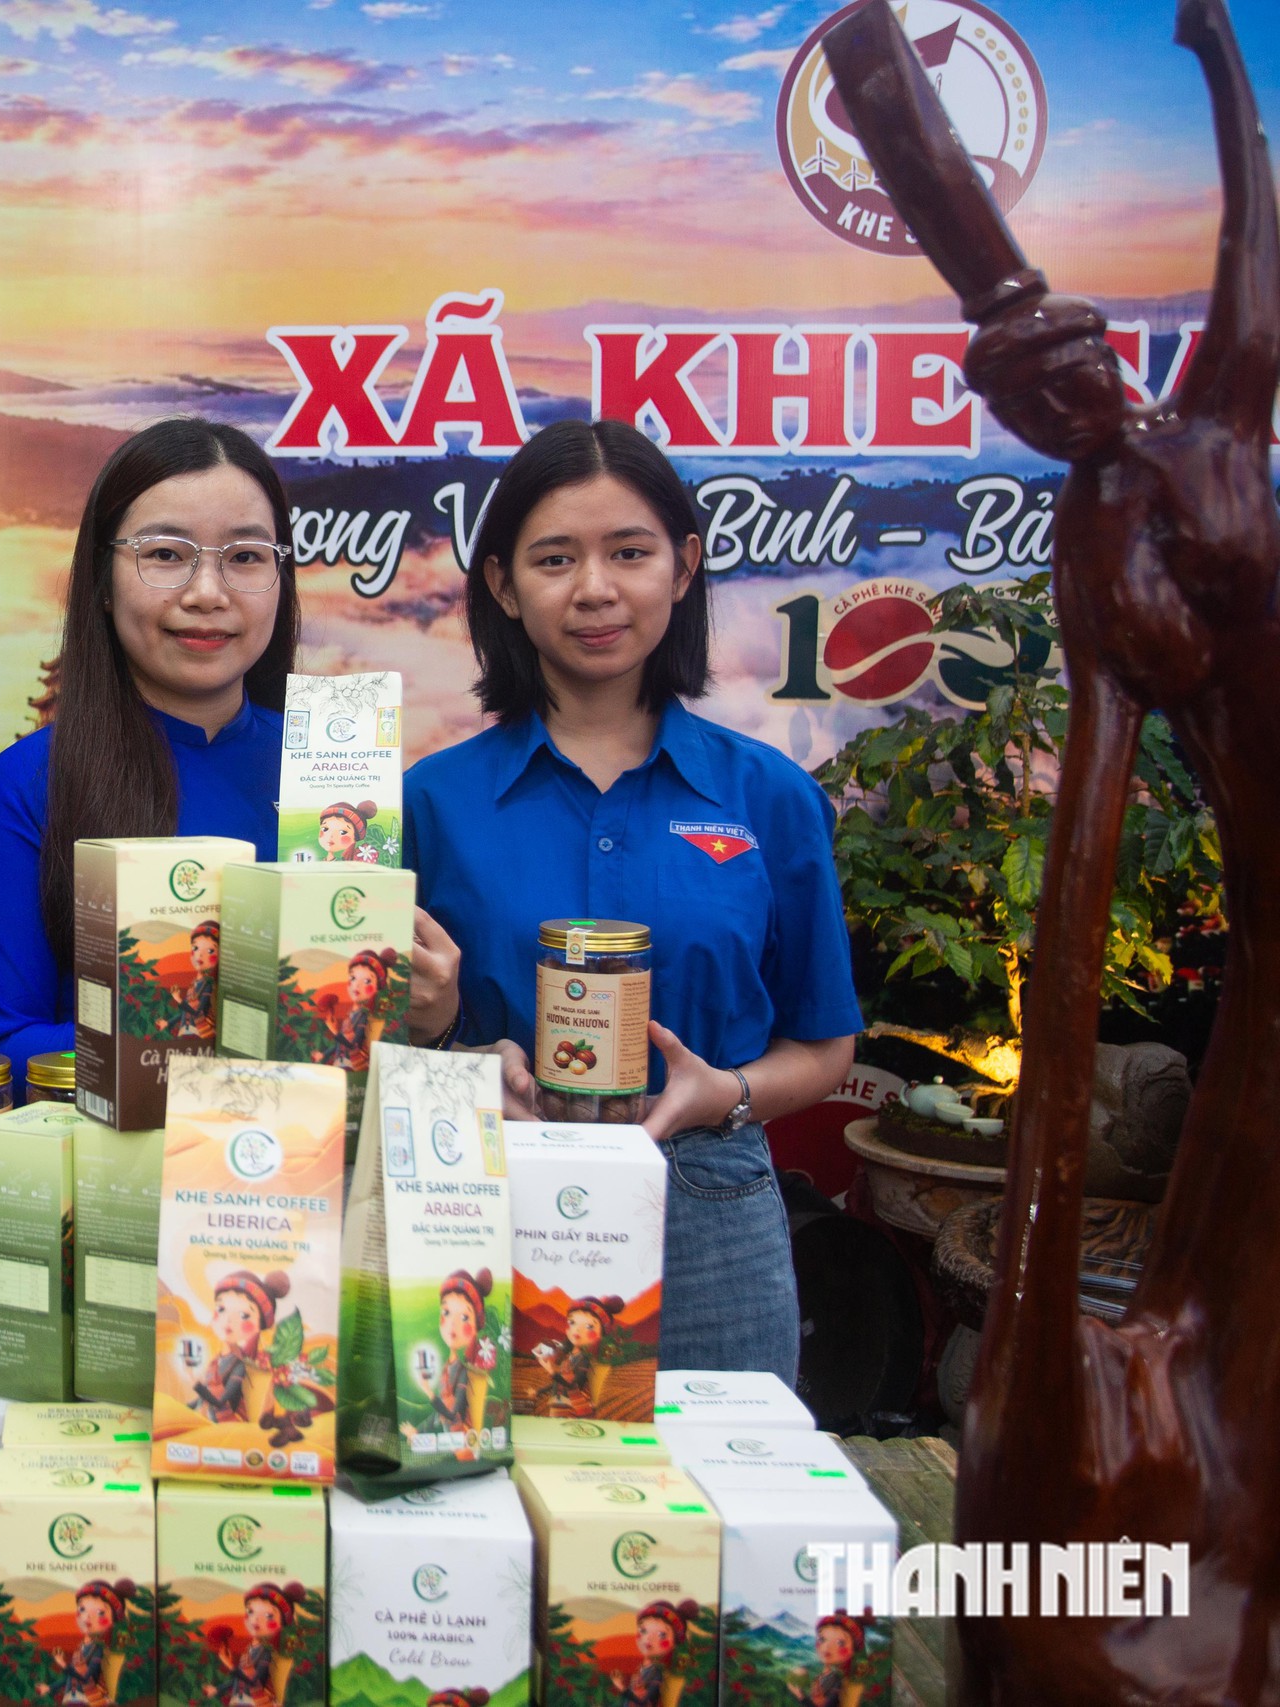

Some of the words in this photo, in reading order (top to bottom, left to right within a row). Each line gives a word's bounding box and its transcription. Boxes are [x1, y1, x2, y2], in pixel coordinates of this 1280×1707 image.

[837, 202, 893, 242] KHE
[268, 290, 524, 455] XÃ
[586, 324, 979, 456] KHE
[290, 506, 412, 596] ơng
[696, 475, 859, 573] Bình
[947, 475, 1056, 573] Bả
[834, 597, 853, 616] CÀ
[852, 583, 880, 604] PHÊ
[884, 584, 913, 598] KHE
[290, 752, 313, 760] KHE
[316, 751, 347, 759] SANH
[351, 750, 392, 759] COFFEE
[311, 762, 369, 772] ARABICA
[675, 824, 701, 832] THANH
[704, 824, 724, 833] NIÊN
[150, 905, 168, 915] KHE
[169, 905, 193, 915] SANH
[310, 935, 328, 943] KHE
[328, 934, 352, 943] SANH
[353, 933, 384, 942] COFFEE
[573, 1017, 610, 1029] KHƯƠNG
[140, 1048, 160, 1066] Cà
[832, 1077, 877, 1100] HE
[395, 1180, 422, 1193] KHE
[426, 1181, 459, 1194] SANH
[463, 1183, 501, 1196] COFFEE
[175, 1190, 208, 1204] KHE
[213, 1192, 260, 1206] SANH
[266, 1196, 329, 1212] COFFEE
[424, 1202, 482, 1217] ARABICA
[207, 1213, 292, 1232] LIBERICA
[515, 1228, 547, 1240] PHIN
[551, 1227, 581, 1241] GIẤY
[586, 1232, 629, 1243] BLEND
[531, 1248, 563, 1264] Drip
[569, 1249, 612, 1267] Coffee
[366, 1508, 393, 1516] KHE
[397, 1509, 434, 1517] SANH
[439, 1511, 488, 1519] COFFEE
[26, 1562, 47, 1572] KHE
[49, 1562, 77, 1572] SANH
[79, 1562, 117, 1572] COFFEE
[194, 1562, 215, 1572] KHE
[217, 1563, 246, 1573] SANH
[248, 1565, 286, 1575] COFFEE
[587, 1581, 608, 1592] KHE
[610, 1581, 640, 1592] SANH
[642, 1582, 681, 1592] COFFEE
[375, 1608, 394, 1623] CÀ
[399, 1609, 427, 1624] PHÊ
[446, 1615, 486, 1627] LẠNH
[387, 1631, 417, 1641] 100%
[422, 1632, 474, 1644] ARABICA
